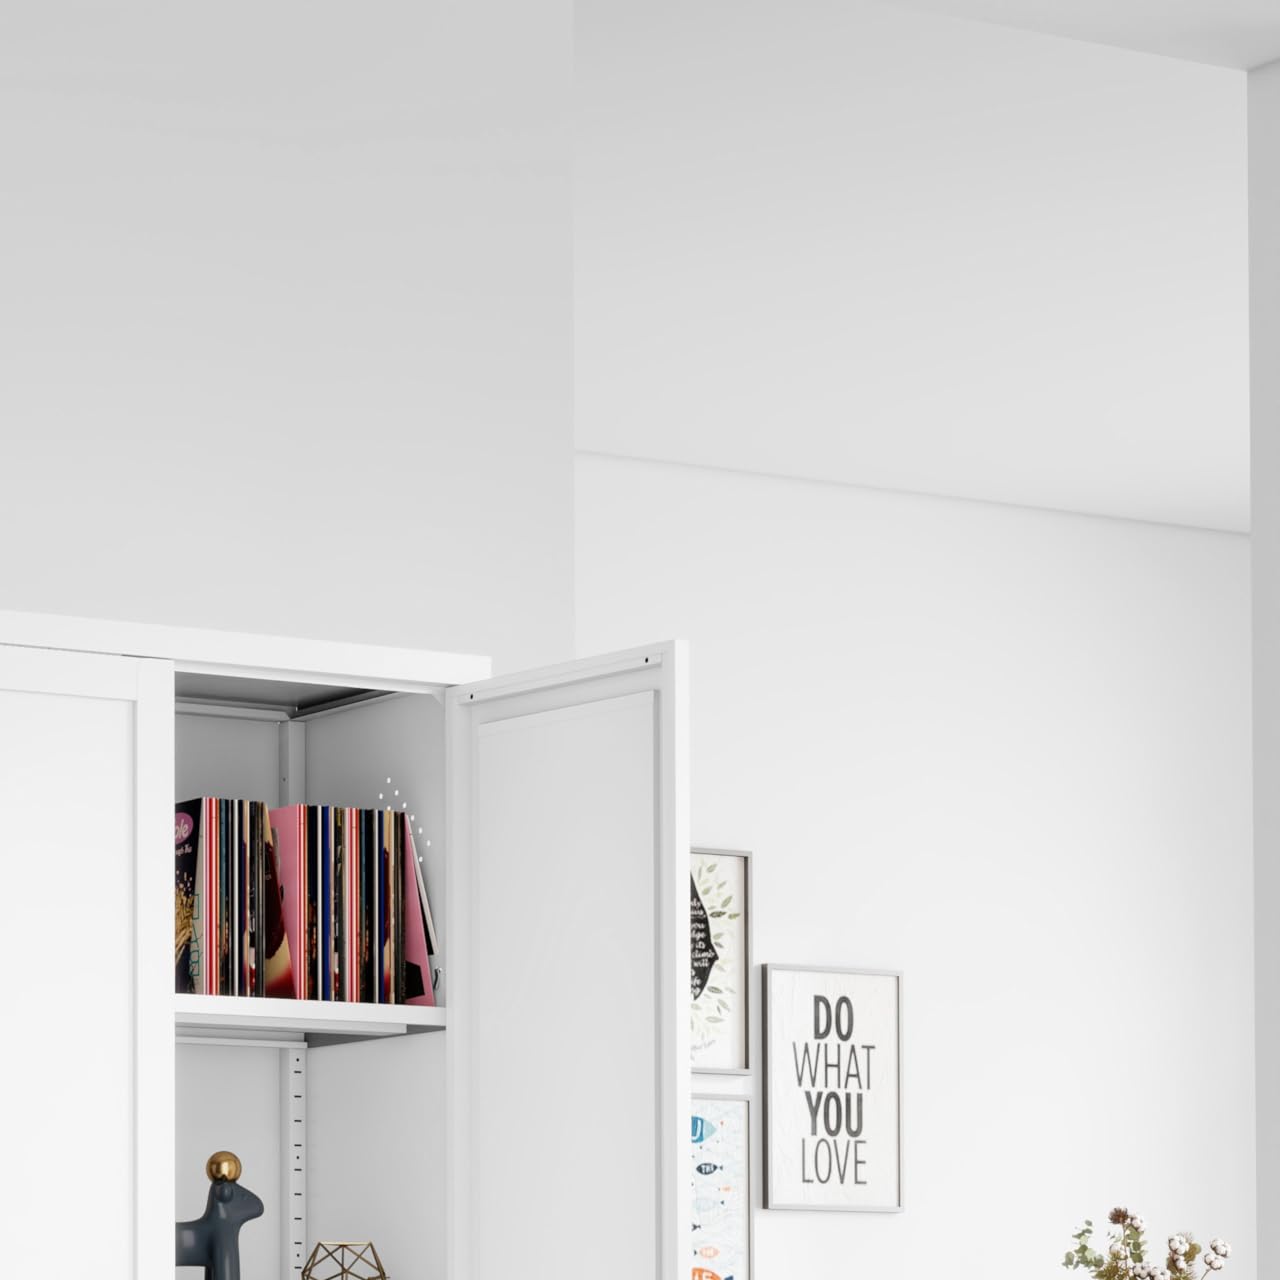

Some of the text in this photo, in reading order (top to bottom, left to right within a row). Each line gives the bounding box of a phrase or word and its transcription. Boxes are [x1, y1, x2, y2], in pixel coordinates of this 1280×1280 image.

[813, 994, 853, 1041] DO
[793, 1041, 875, 1090] WHAT
[805, 1090, 863, 1138] YOU
[801, 1137, 867, 1185] LOVE
